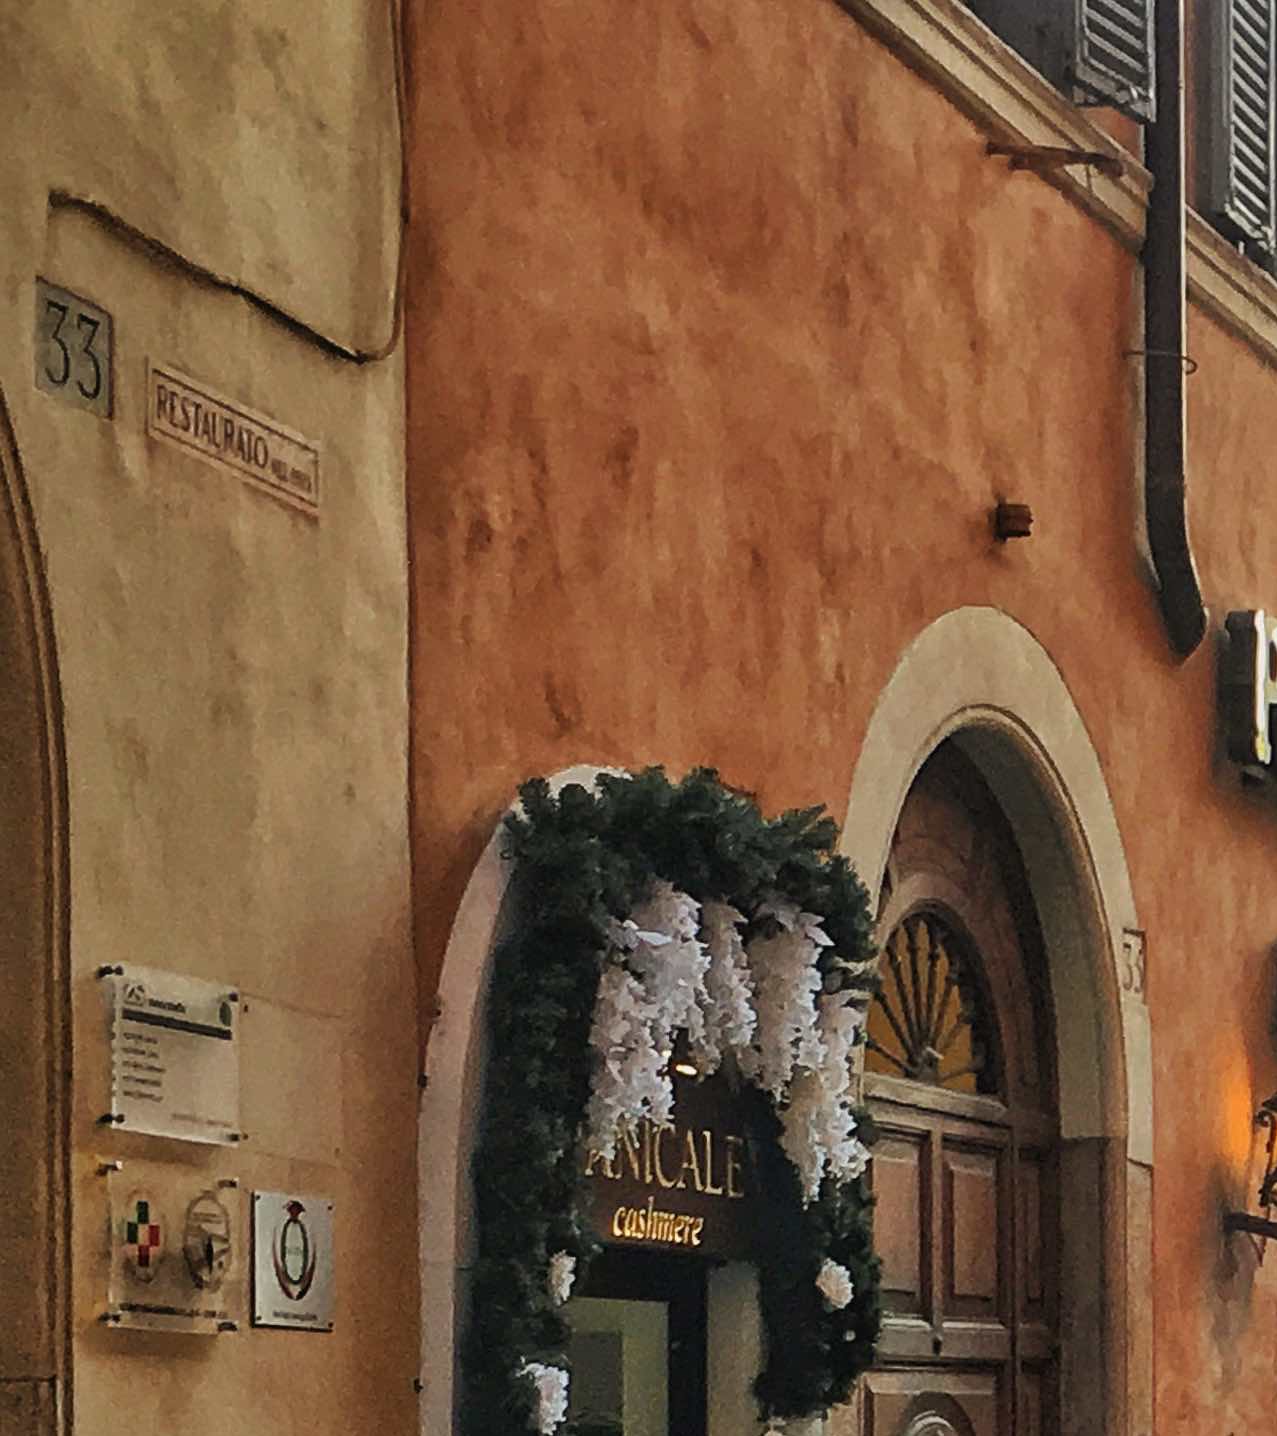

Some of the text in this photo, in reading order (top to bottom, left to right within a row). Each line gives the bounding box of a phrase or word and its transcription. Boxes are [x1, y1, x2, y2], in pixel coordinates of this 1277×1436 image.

[45, 300, 102, 401] 33
[156, 384, 269, 469] RESTAURATO
[611, 1197, 705, 1247] cashmere
